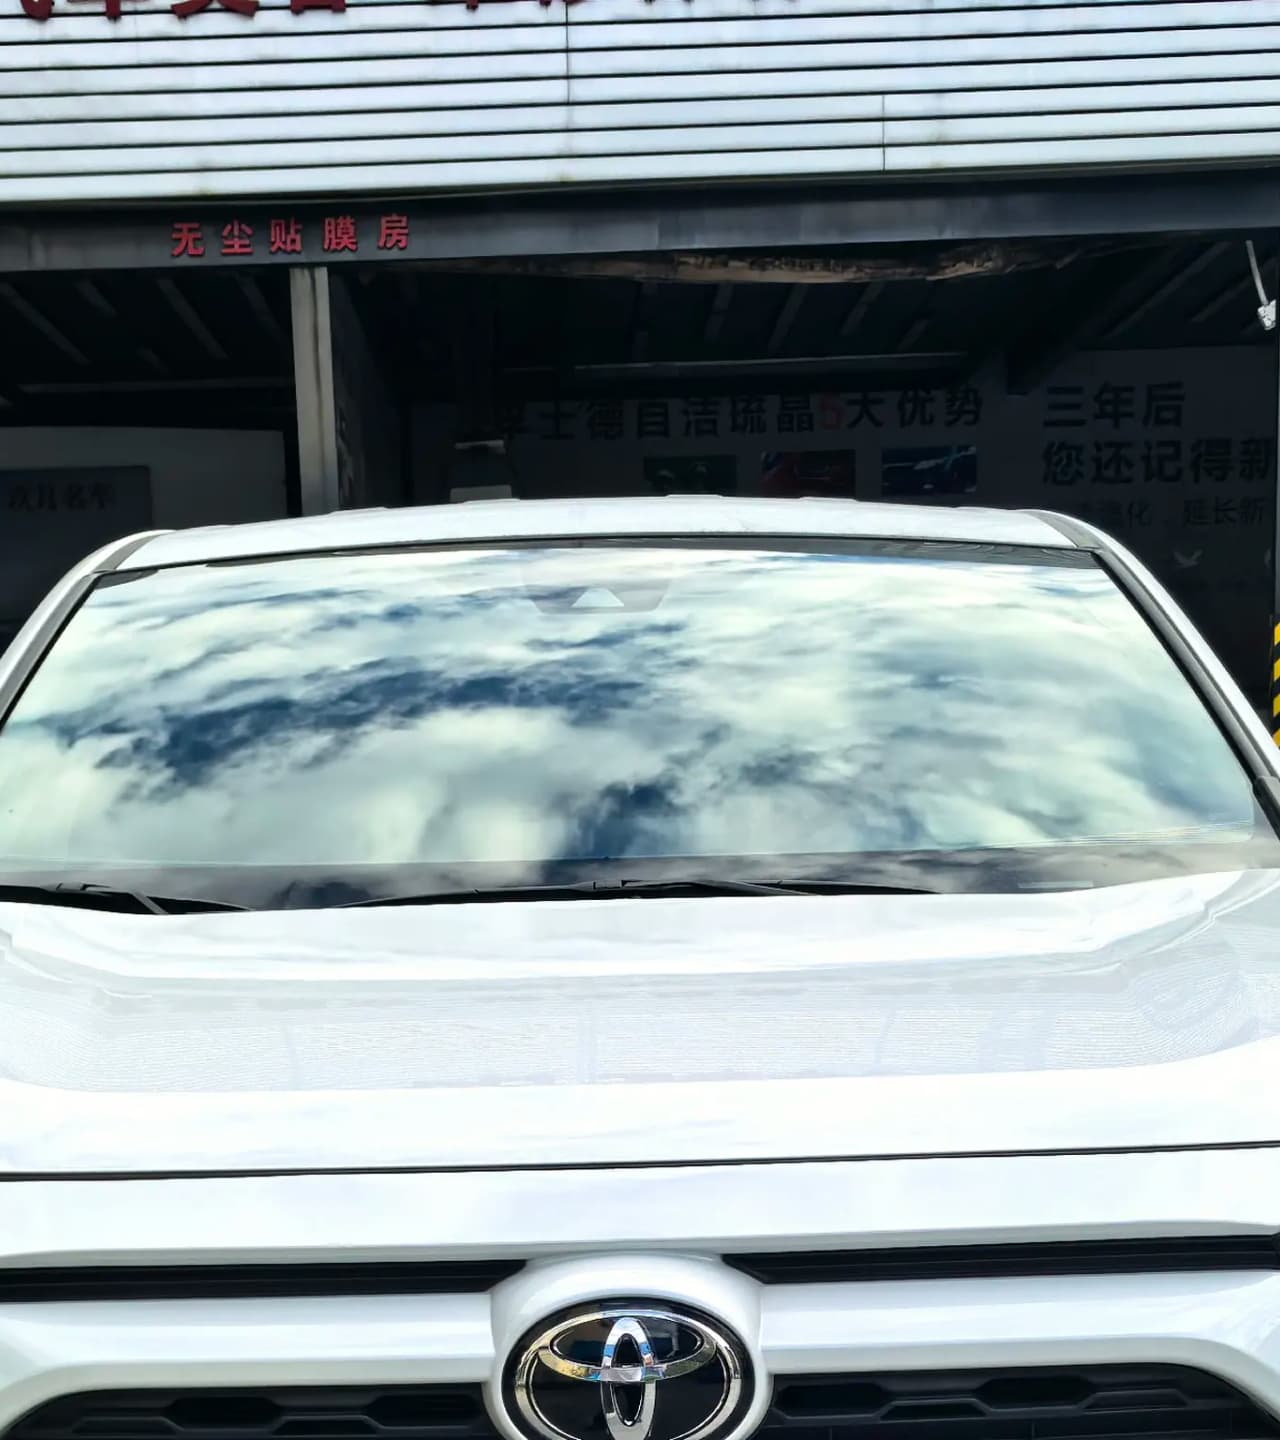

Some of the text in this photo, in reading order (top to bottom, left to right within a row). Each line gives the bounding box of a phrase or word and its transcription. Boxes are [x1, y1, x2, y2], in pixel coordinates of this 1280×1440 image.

[171, 213, 410, 257] 无尘贴膜房
[1042, 380, 1186, 430] 三年后
